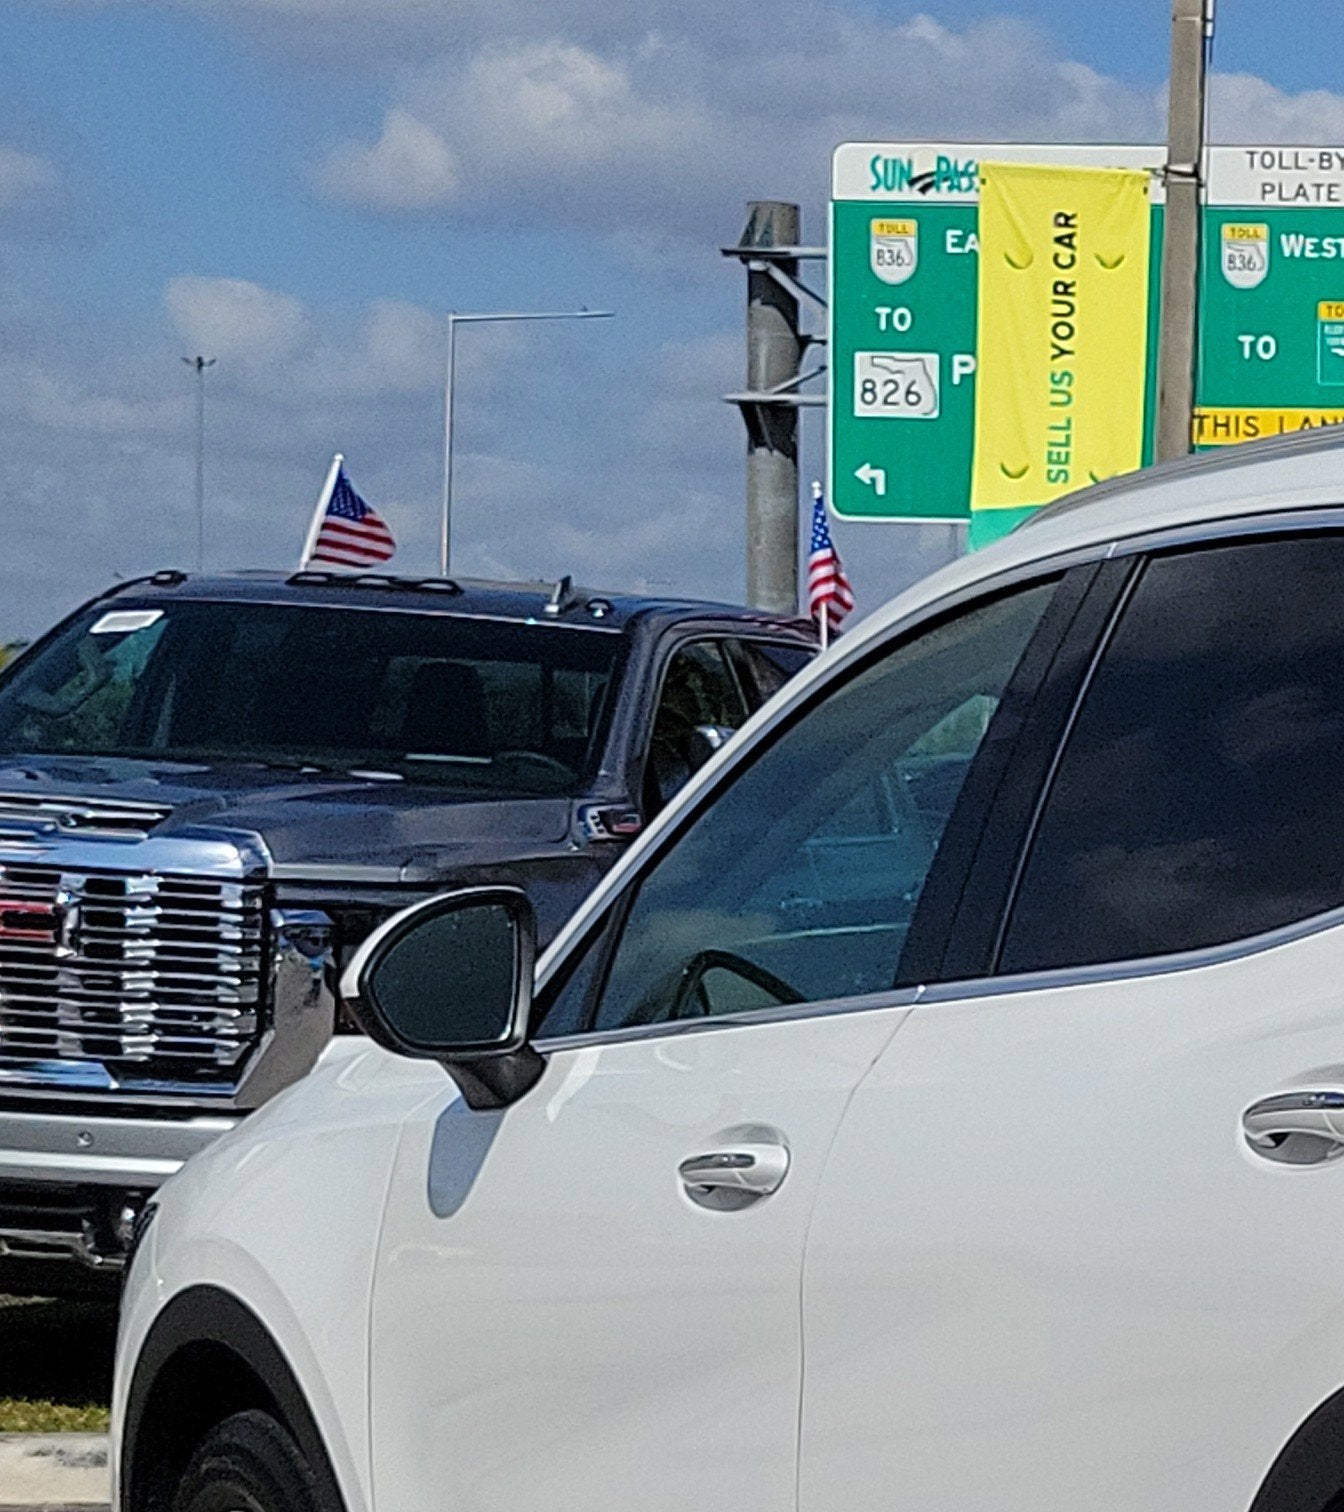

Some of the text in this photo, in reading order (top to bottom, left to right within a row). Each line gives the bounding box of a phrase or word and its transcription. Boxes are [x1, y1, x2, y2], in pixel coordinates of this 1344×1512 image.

[1261, 183, 1341, 202] PLATE
[878, 222, 909, 235] TOLL
[1230, 228, 1260, 239] TOLL
[876, 248, 905, 267] 836
[1227, 254, 1256, 272] 836
[875, 307, 912, 331] TO
[1046, 211, 1078, 484] SELL US YOUR CAR
[1237, 336, 1276, 360] TO
[860, 378, 922, 406] 826
[1193, 414, 1260, 437] THIS
